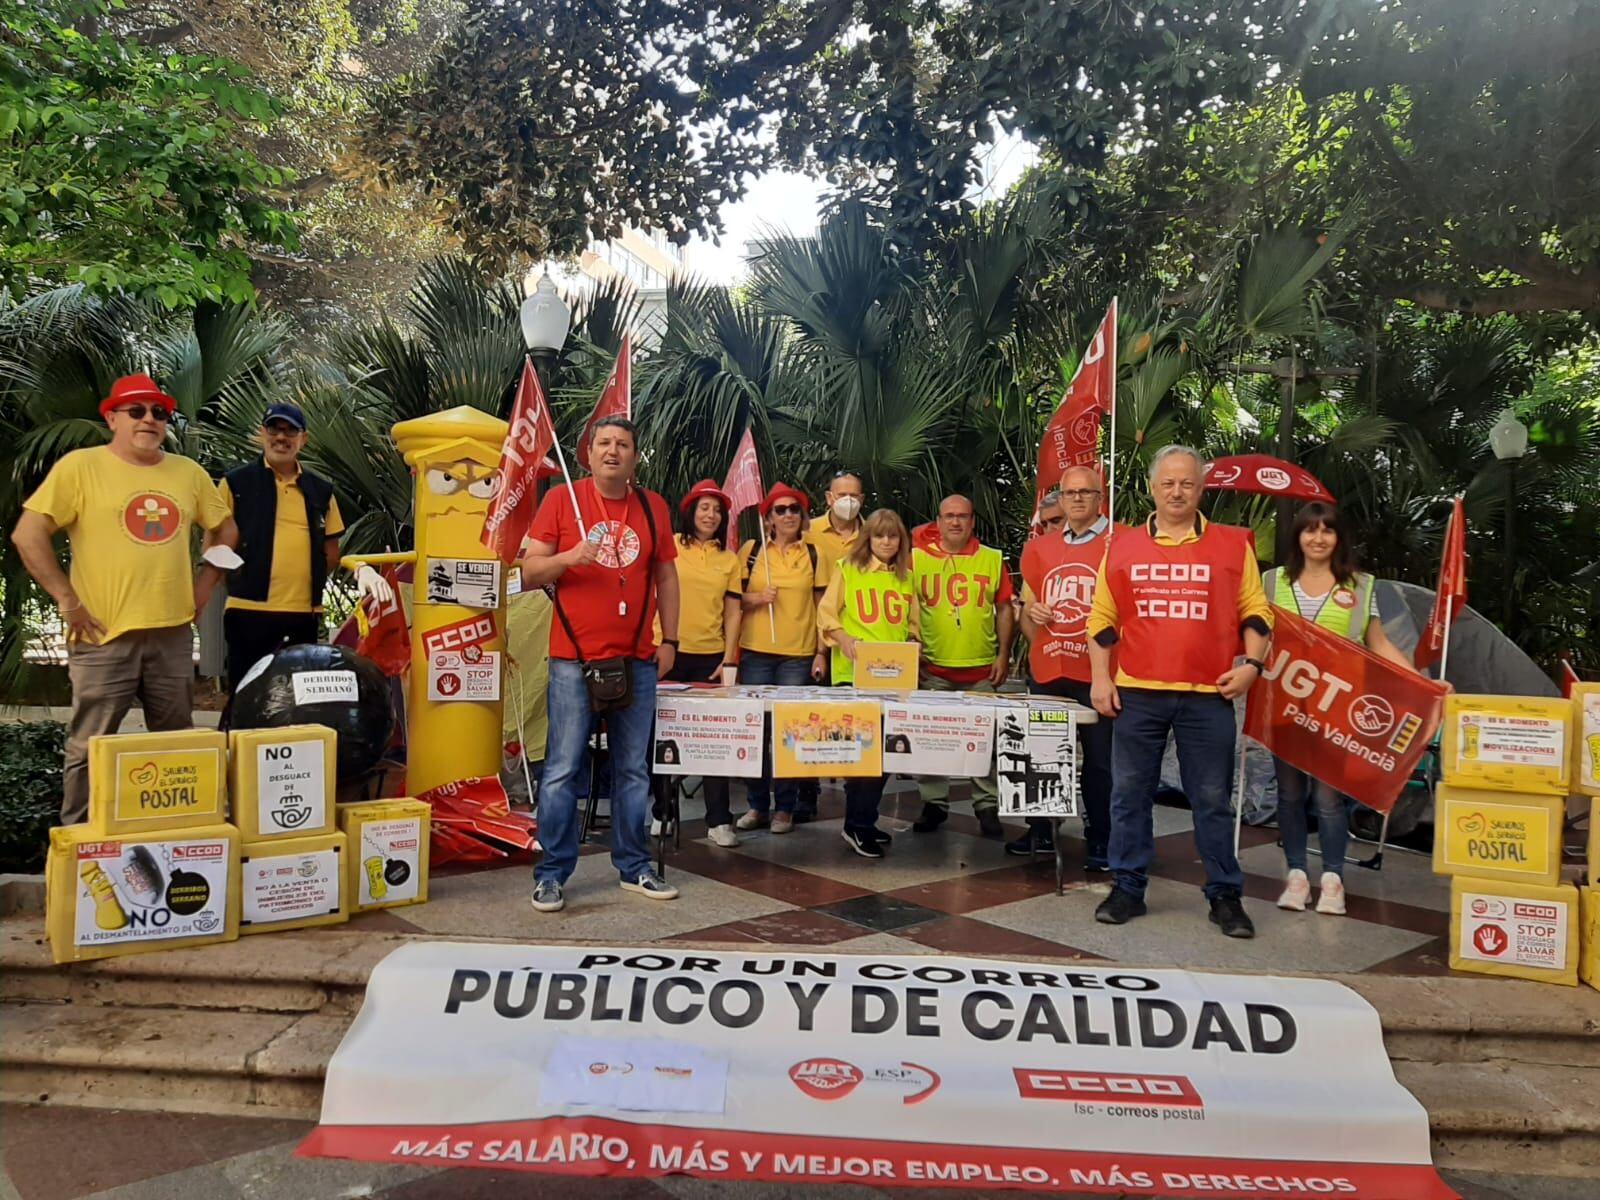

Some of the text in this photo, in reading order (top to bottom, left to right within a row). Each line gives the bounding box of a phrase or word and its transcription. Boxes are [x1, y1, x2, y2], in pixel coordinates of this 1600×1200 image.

[1261, 470, 1285, 480] UGT
[458, 563, 493, 574] SE VENDE
[1131, 564, 1210, 582] CCOO
[921, 573, 991, 608] UGT
[1046, 575, 1095, 606] UGT
[1140, 587, 1170, 595] sindicato
[1182, 588, 1208, 596] Correos
[1135, 599, 1208, 620] CCOO
[426, 618, 492, 652] CCOO
[467, 670, 493, 678] STOP
[702, 715, 737, 723] MOMENTO
[1030, 710, 1068, 721] SE VENDE
[1282, 703, 1396, 772] País Valencià
[265, 746, 292, 760] NO
[1484, 743, 1555, 754] MOVILIZACIONES
[269, 772, 311, 782] DESGUACE
[140, 787, 198, 809] POSTAL
[78, 843, 103, 854] UGT
[188, 846, 221, 856] CCOO
[1468, 839, 1528, 862] POSTAL
[130, 907, 171, 929] NO
[1516, 905, 1555, 917] CCOO
[93, 925, 180, 940] DESMANTELAMIENTO
[182, 925, 192, 933] DE
[1518, 925, 1556, 937] STOP
[1517, 946, 1555, 955] SALVAR
[578, 953, 1160, 991] POR UN CORREO
[444, 966, 1298, 1054] PÚBLICO Y DE CALIDAD
[797, 1063, 853, 1075] UGT
[1028, 1074, 1184, 1096] CCOO
[1074, 1102, 1094, 1115] fsc
[1107, 1106, 1158, 1118] correos
[1163, 1109, 1205, 1120] postal
[391, 1135, 473, 1160] MÁS
[479, 1132, 636, 1170] SALARIO,
[649, 1140, 729, 1171] MÁS
[740, 1151, 763, 1172] Y
[773, 1153, 896, 1178] MEJOR
[1069, 1164, 1155, 1188] MÁS
[1162, 1172, 1358, 1193] DERECHOS
